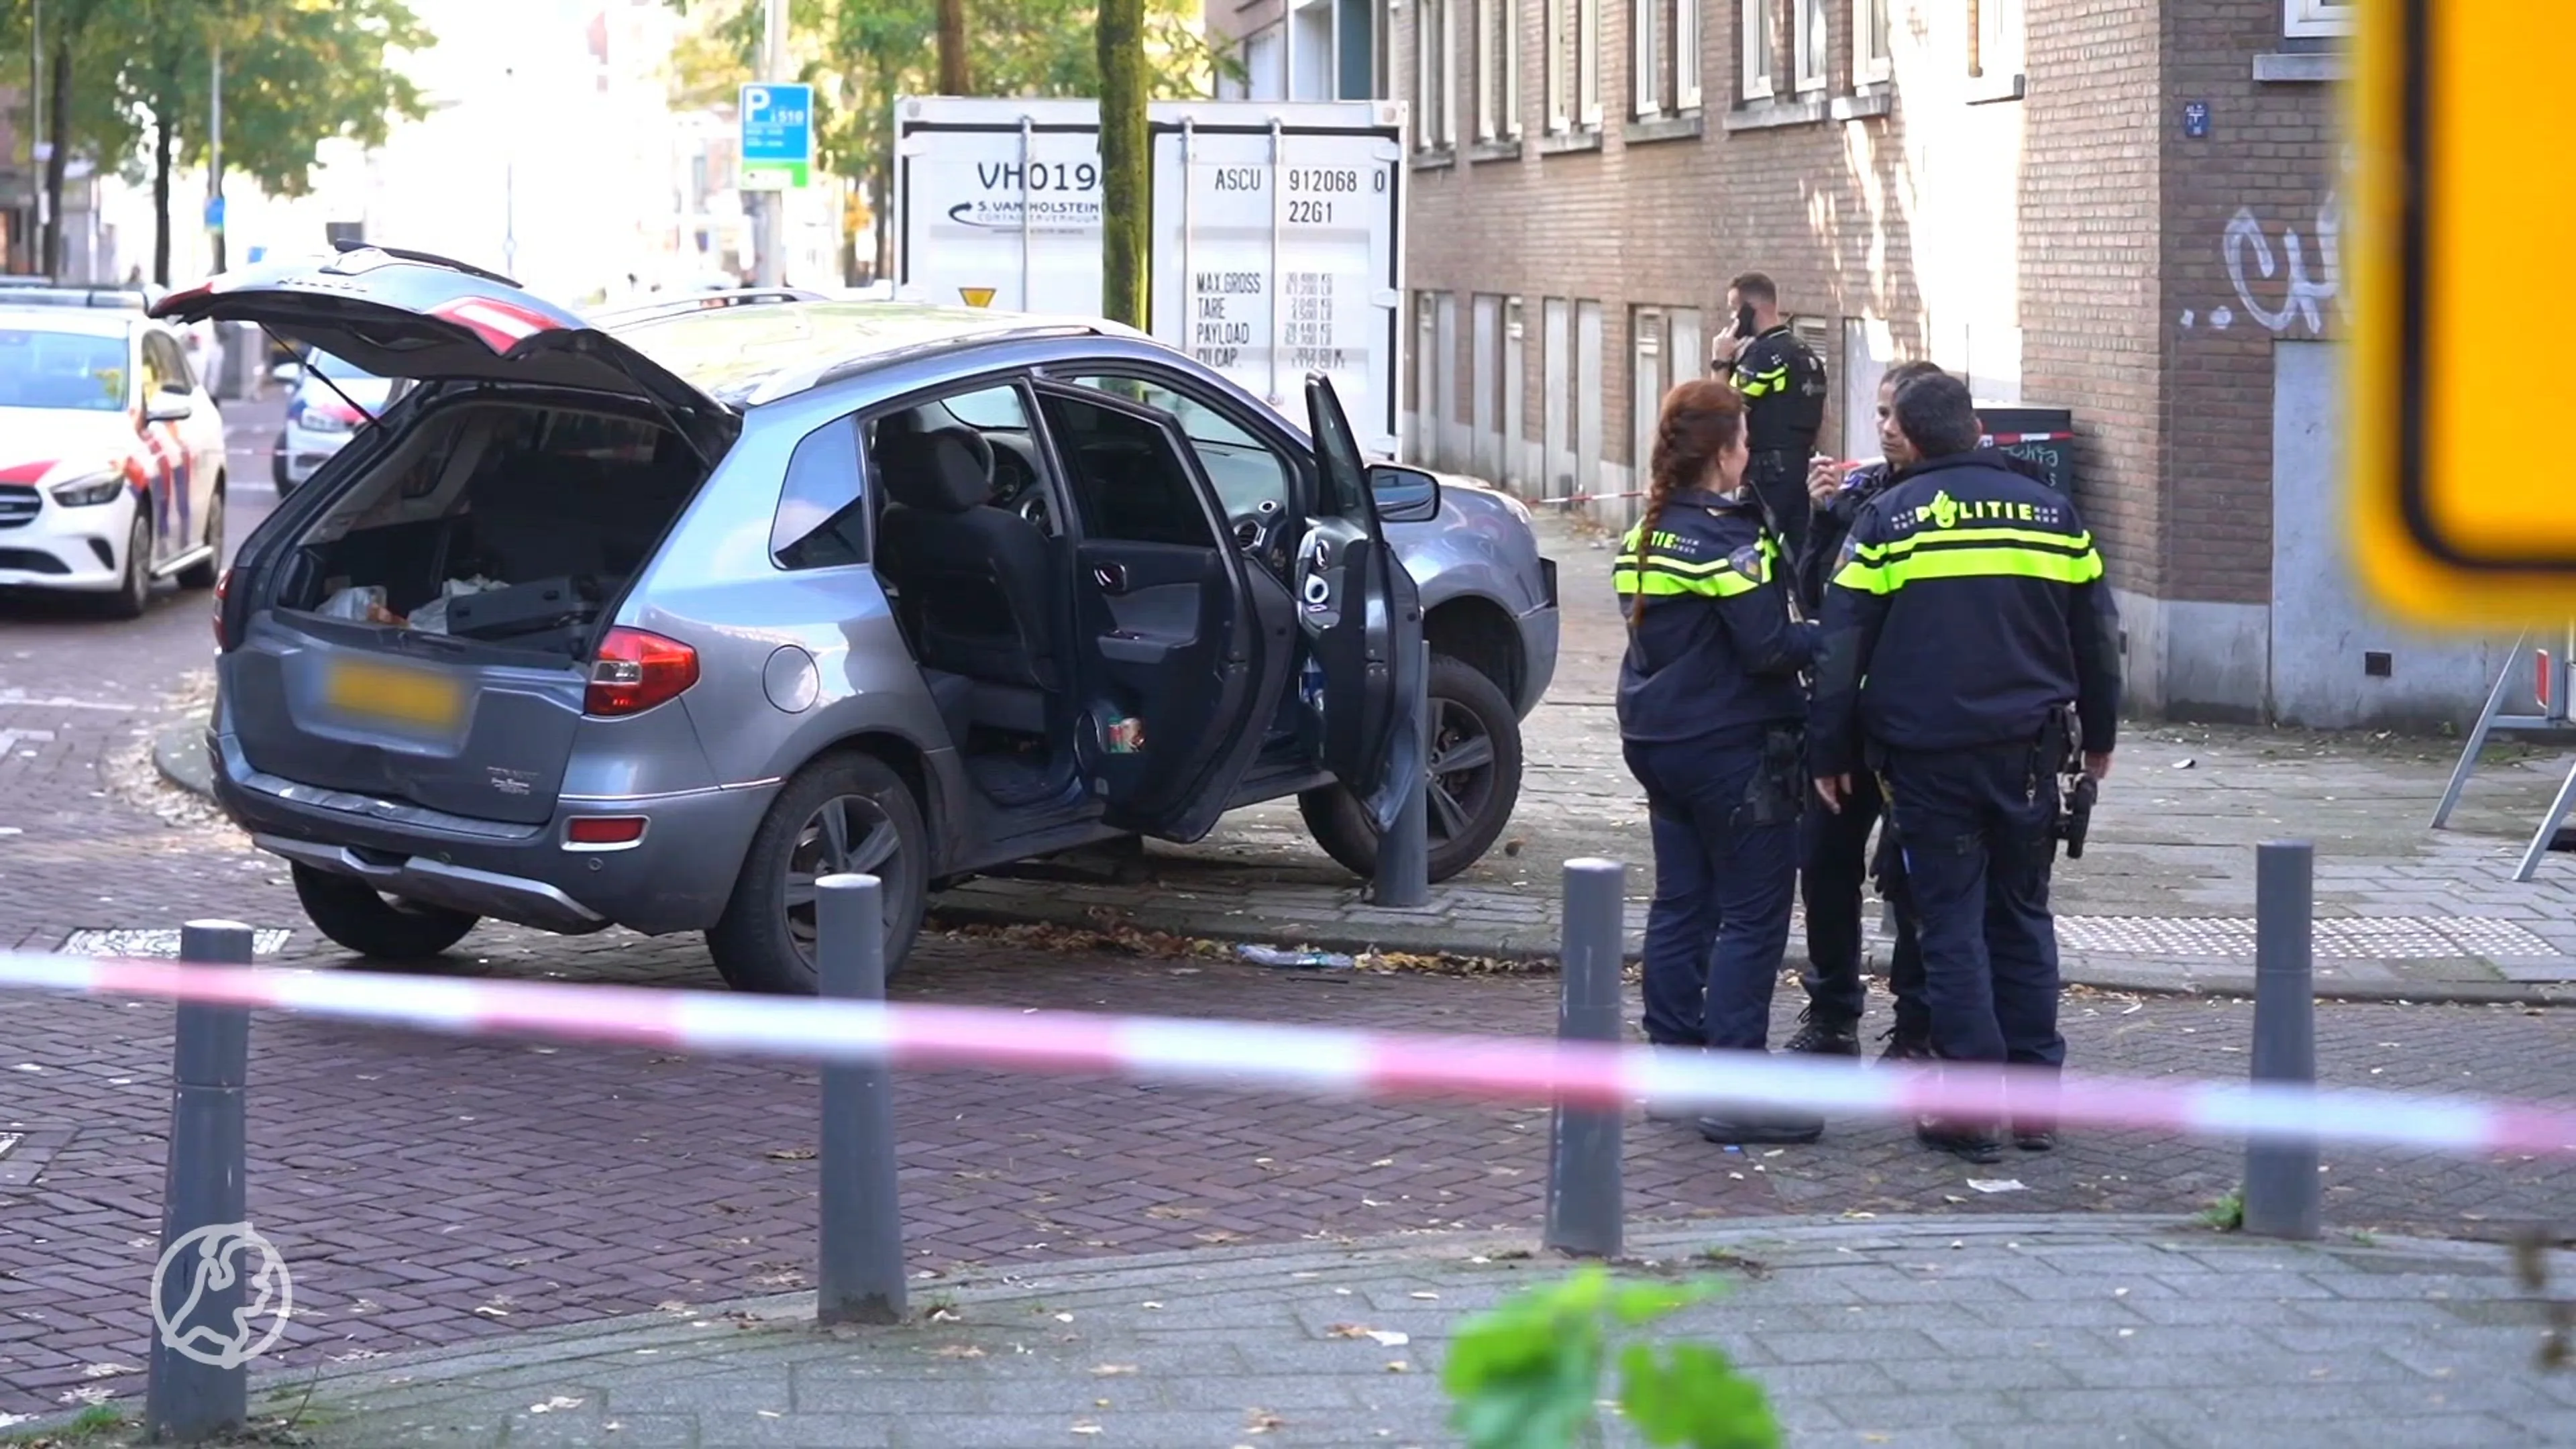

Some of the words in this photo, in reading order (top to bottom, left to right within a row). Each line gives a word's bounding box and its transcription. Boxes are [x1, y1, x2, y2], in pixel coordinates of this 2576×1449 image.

[745, 89, 770, 122] P
[977, 162, 1102, 191] VH019
[1215, 168, 1260, 191] ASCU
[1289, 169, 1357, 193] 912068
[1375, 170, 1385, 193] 0
[1029, 202, 1099, 213] HOLSTEIN
[1289, 201, 1332, 223] 22G1
[1197, 297, 1226, 319] TARE
[1197, 323, 1250, 344] PAYLOAD
[1916, 490, 2033, 529] POLITIE
